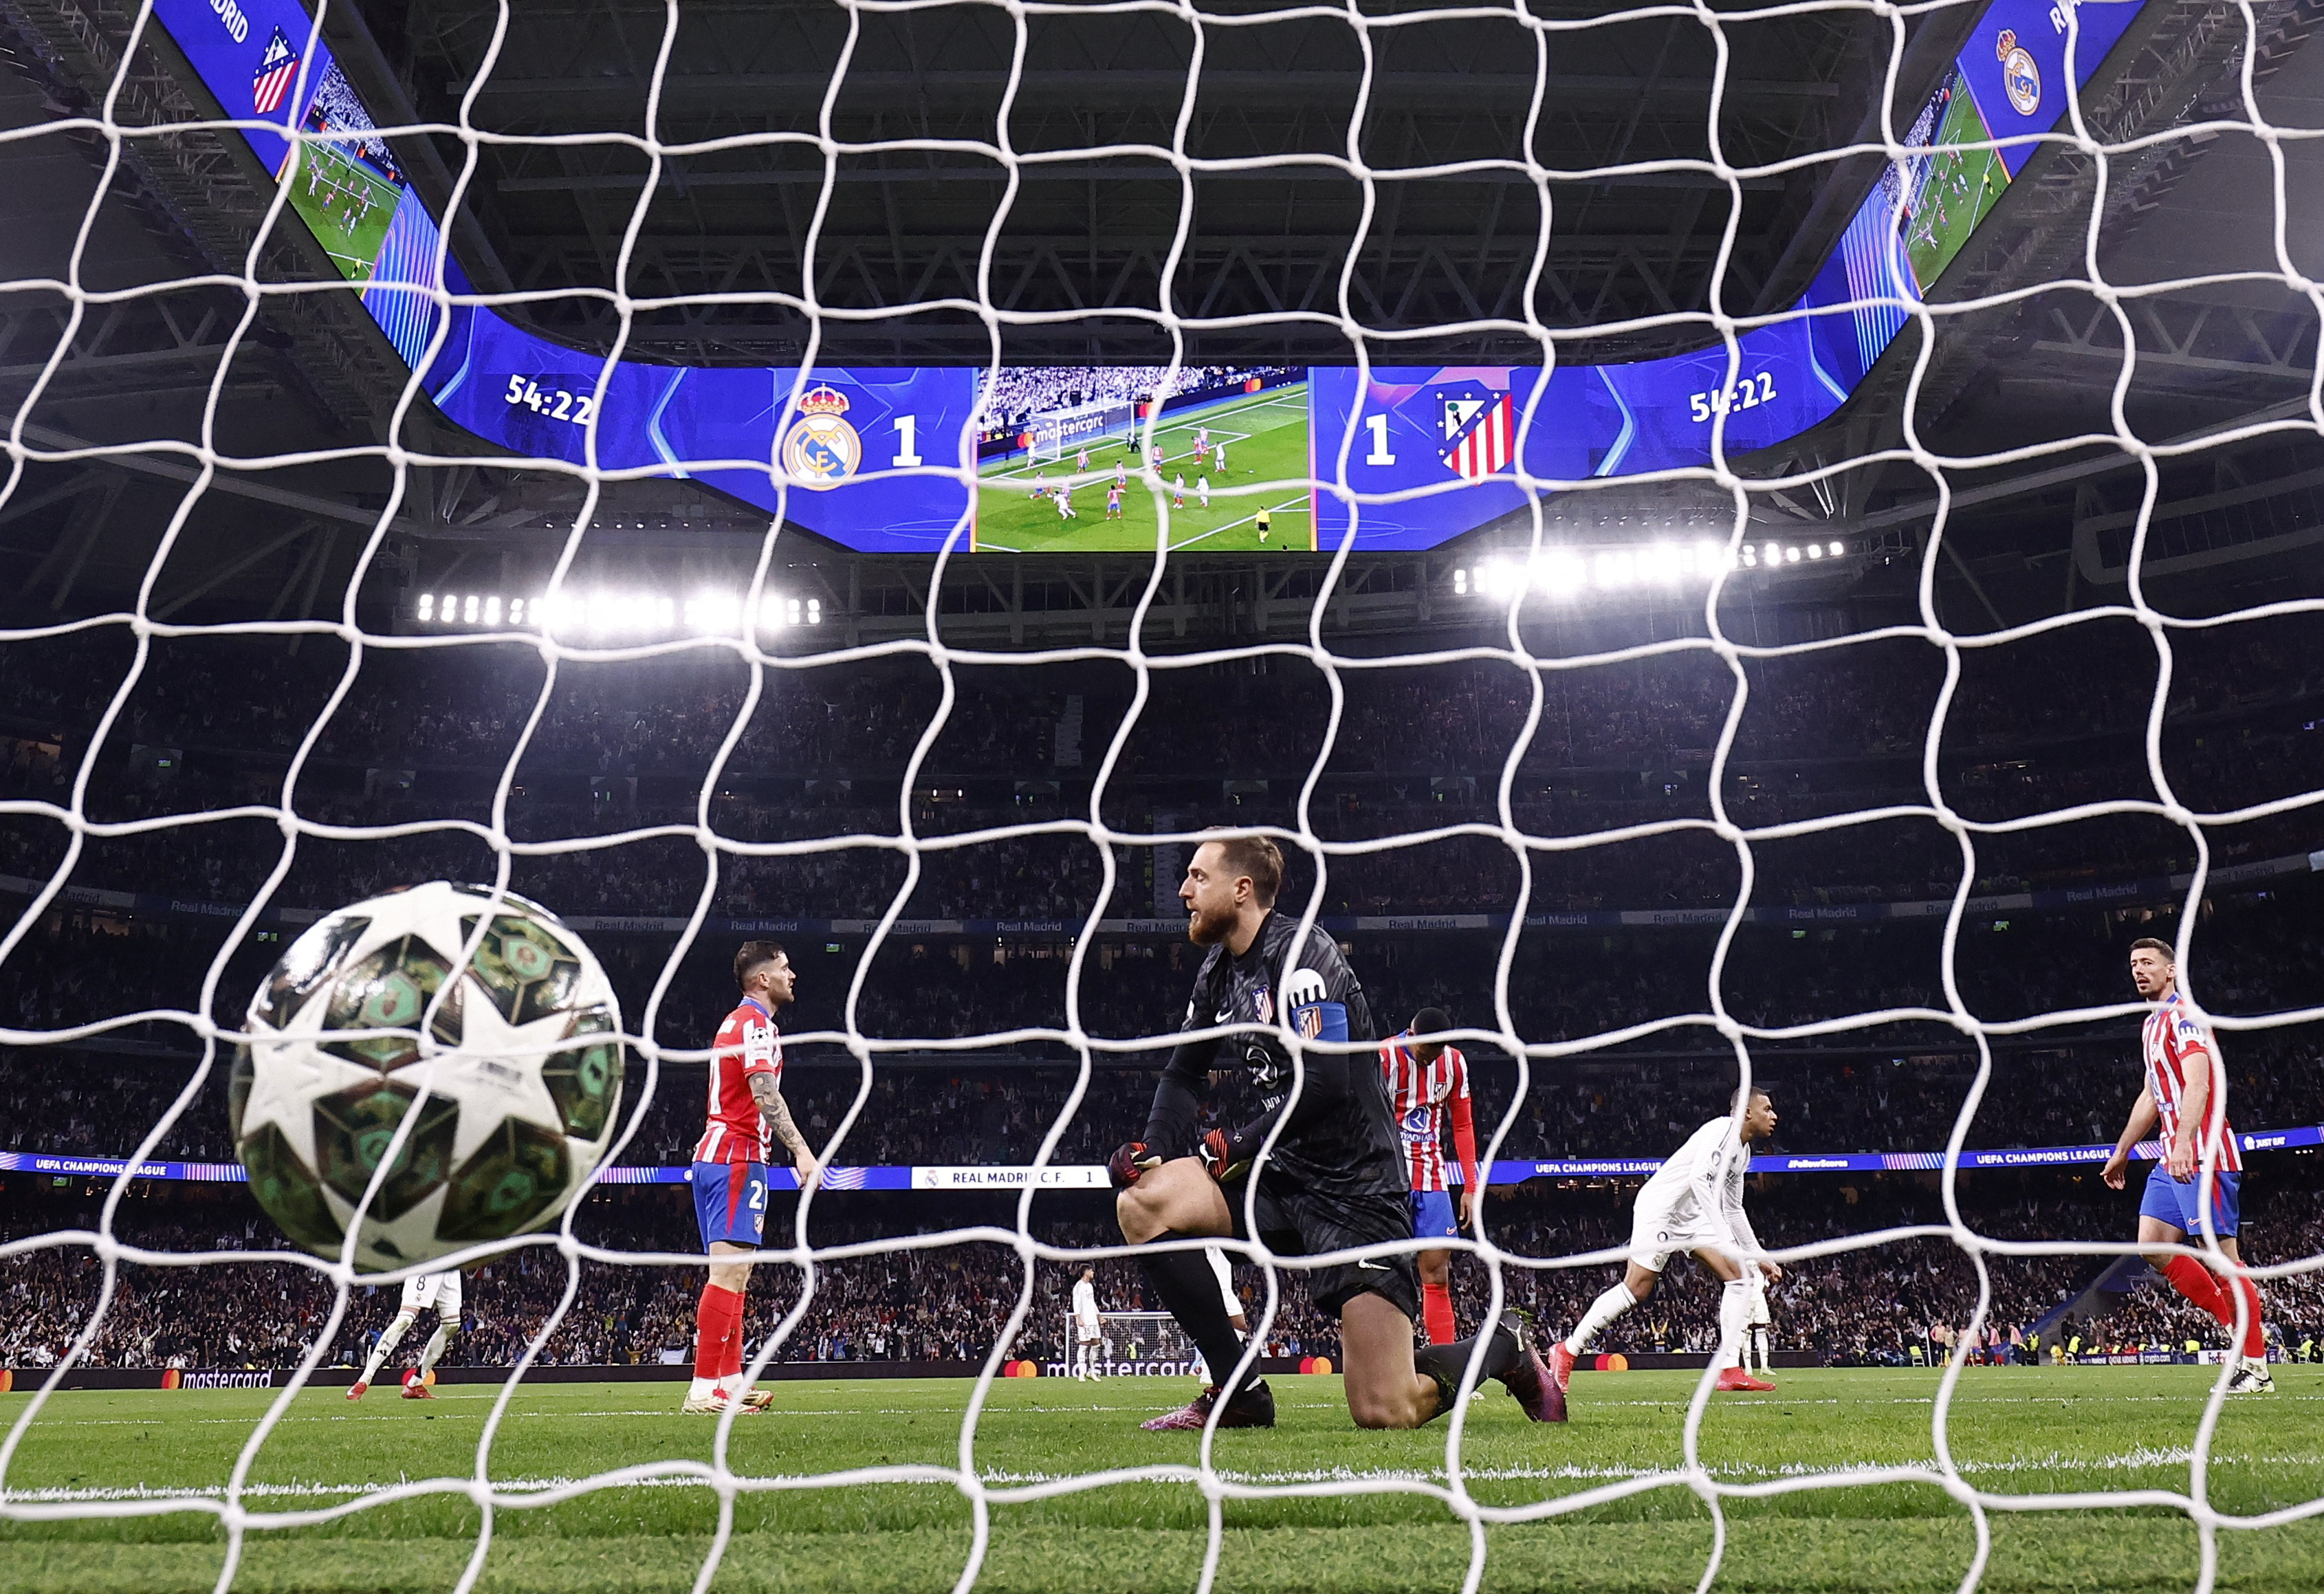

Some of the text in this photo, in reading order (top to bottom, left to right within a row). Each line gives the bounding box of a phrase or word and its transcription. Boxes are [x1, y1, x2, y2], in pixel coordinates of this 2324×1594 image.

[505, 373, 593, 426] 54:22
[1690, 371, 1777, 423] 54:22
[892, 414, 923, 466] 1
[1366, 413, 1396, 466] 1
[2066, 884, 2138, 902] Real Madrid
[171, 900, 243, 917] Real Madrid
[1789, 908, 1857, 919] Real Madrid
[1389, 919, 1457, 929] Real Madrid
[1548, 915, 1588, 925] Madrid
[1654, 914, 1679, 924] Real
[595, 920, 664, 930] Real Madrid
[731, 920, 798, 931] Real Madrid
[892, 923, 931, 932] Madrid
[997, 921, 1062, 931] Real Madrid
[1127, 922, 1151, 932] Real
[2255, 1137, 2285, 1148] JUST EAT
[1977, 1149, 2112, 1165] UEFA CHAMPIONS LEAGUE
[36, 1159, 61, 1170] UEFA
[63, 1161, 124, 1174] CHAMPIONS
[1535, 1161, 1662, 1173] UEFA CHAMPIONS LEAGUE
[953, 1171, 1093, 1183] REAL MADRI C. F. 1
[417, 1274, 426, 1291] 8
[1083, 1327, 1091, 1335] 35
[2145, 1354, 2171, 1364] crypto.com
[183, 1368, 272, 1389] mastercard
